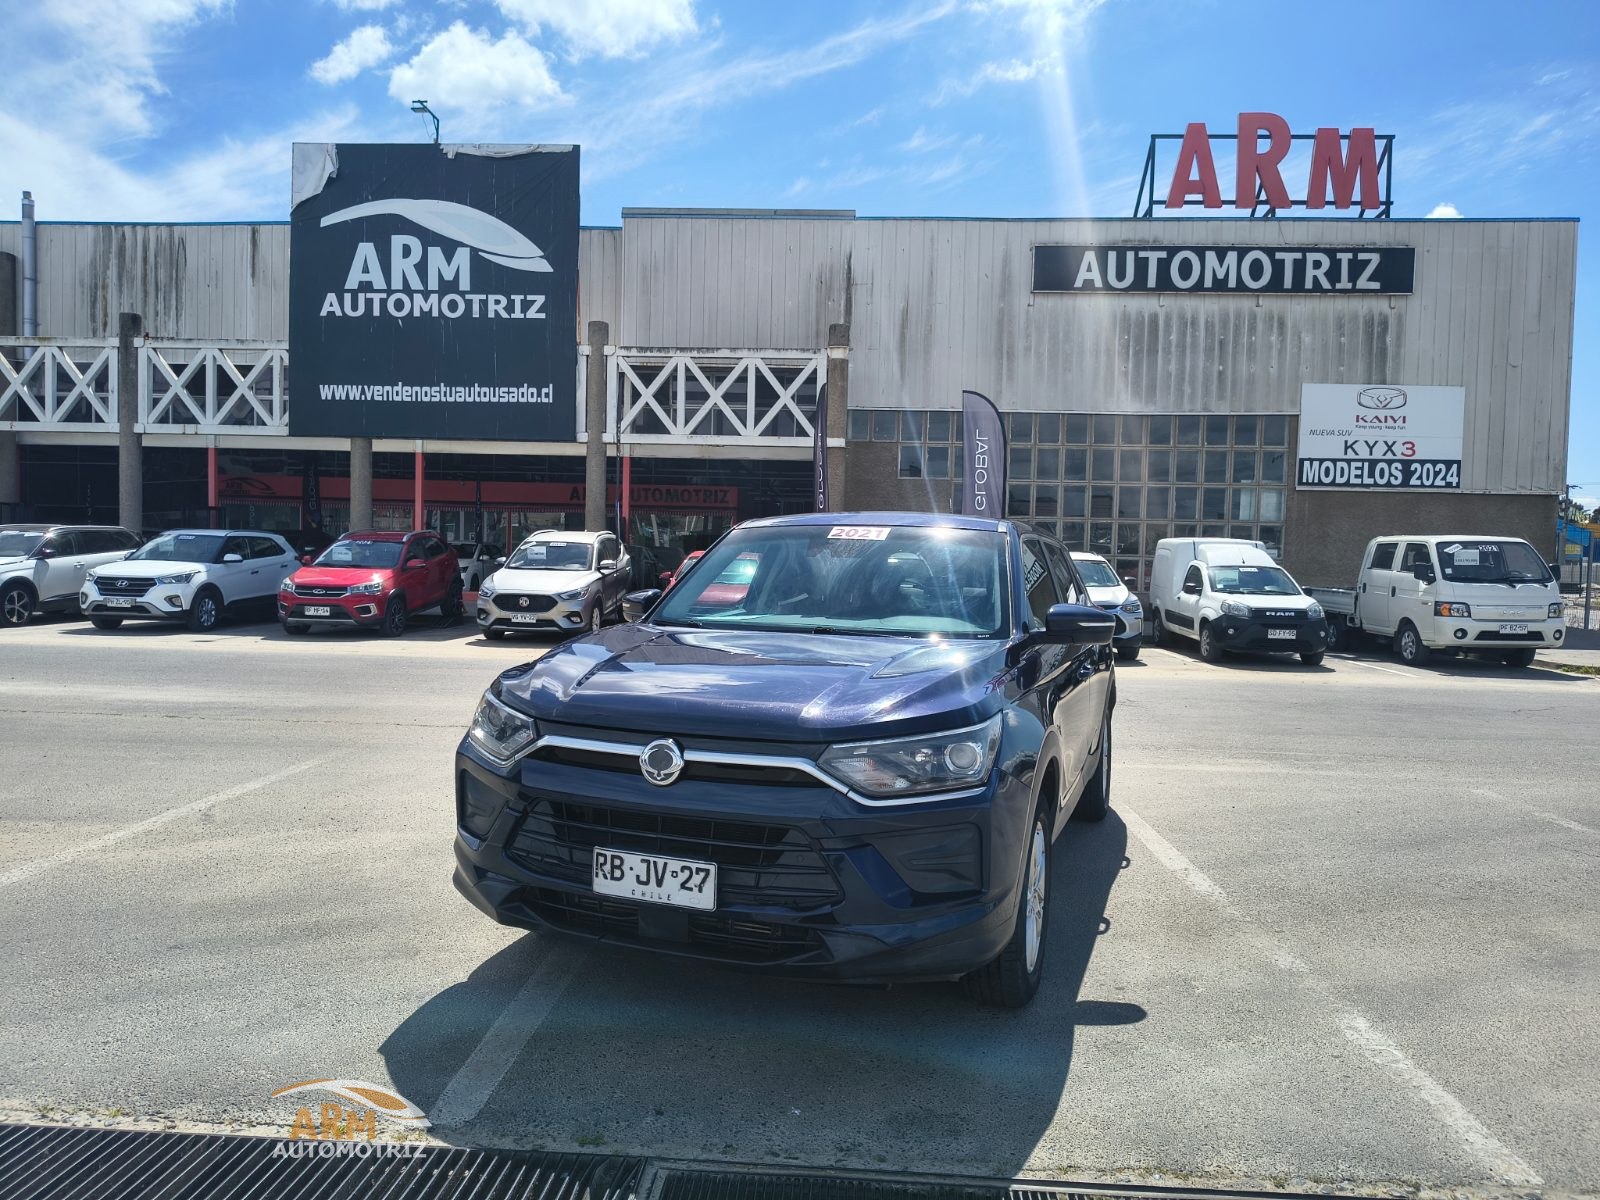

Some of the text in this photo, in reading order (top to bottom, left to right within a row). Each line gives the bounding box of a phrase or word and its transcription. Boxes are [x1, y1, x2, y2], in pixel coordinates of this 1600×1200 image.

[1164, 112, 1380, 209] ARM
[344, 234, 471, 291] ARM
[1073, 249, 1381, 290] AUTOMOTRIZ
[319, 292, 547, 319] AUTOMOTRIZ
[319, 382, 554, 404] www.vendenostuautousado.cl
[1309, 429, 1353, 437] NUEVA SUV
[1343, 440, 1416, 458] KYX3
[974, 428, 989, 511] GLOBAL
[1302, 460, 1459, 487] MODELOS 2024
[630, 487, 730, 504] UTOMOTRIZ
[831, 527, 885, 540] 2021
[631, 889, 673, 902] CHILE
